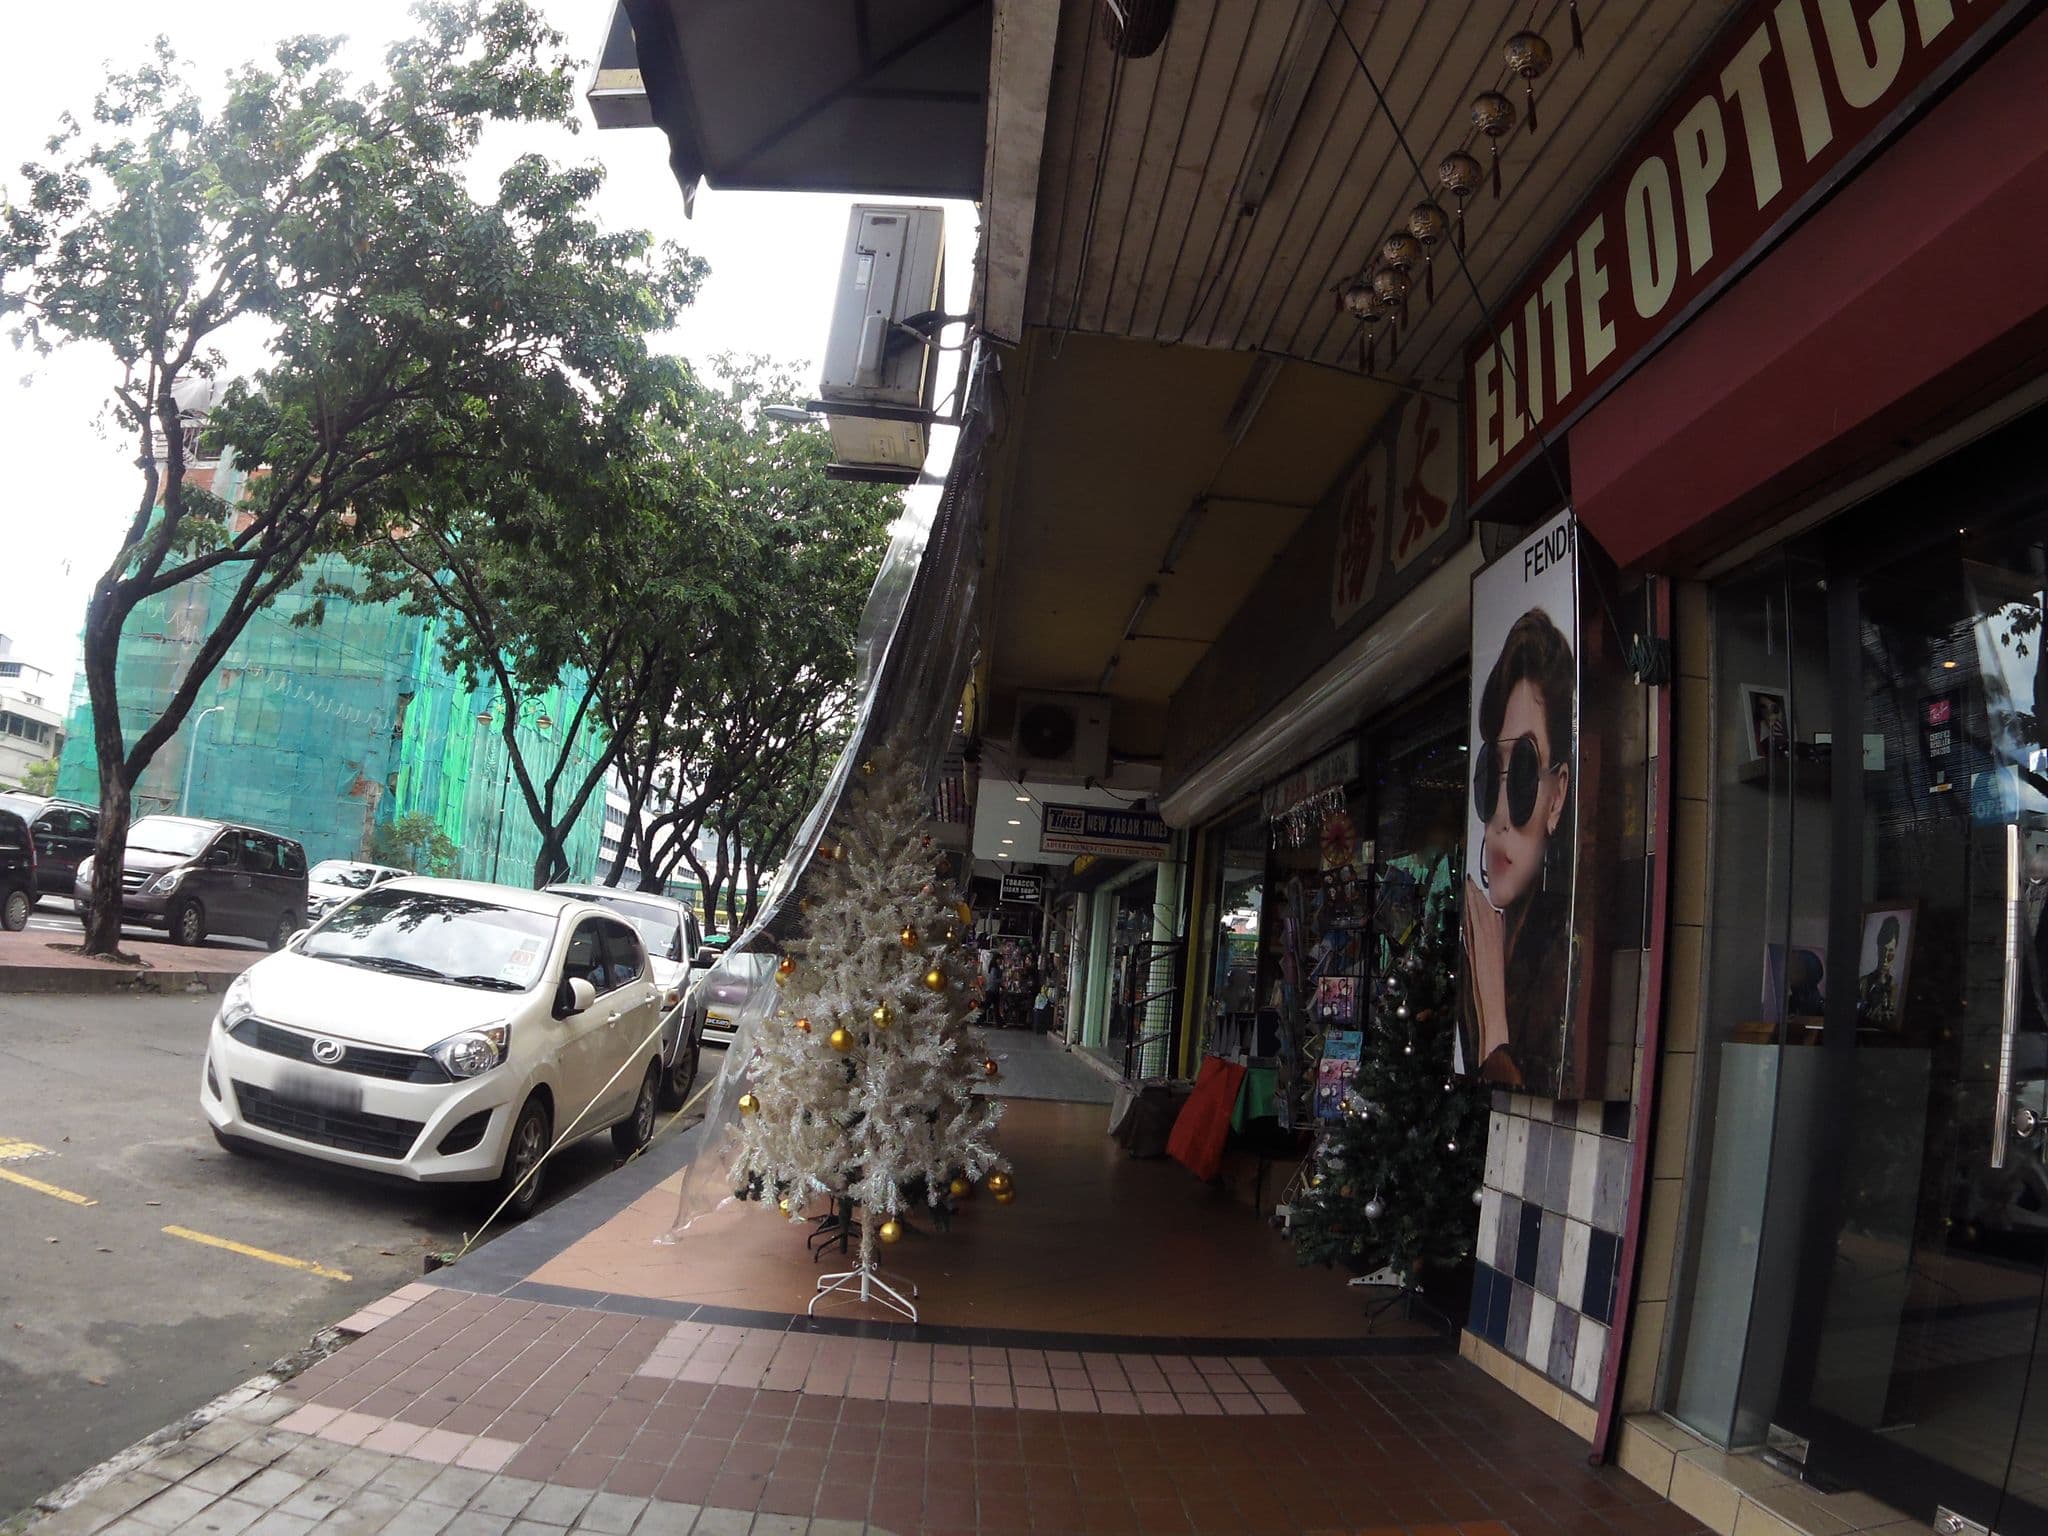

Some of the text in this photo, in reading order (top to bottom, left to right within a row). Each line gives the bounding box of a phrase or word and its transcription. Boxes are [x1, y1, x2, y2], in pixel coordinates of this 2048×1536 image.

[1474, 0, 1975, 482] ELITE OPTIC
[1523, 519, 1573, 583] FENDI
[1087, 815, 1108, 834] NEW
[1109, 818, 1139, 836] SABAH
[1005, 878, 1034, 887] TOBACCO
